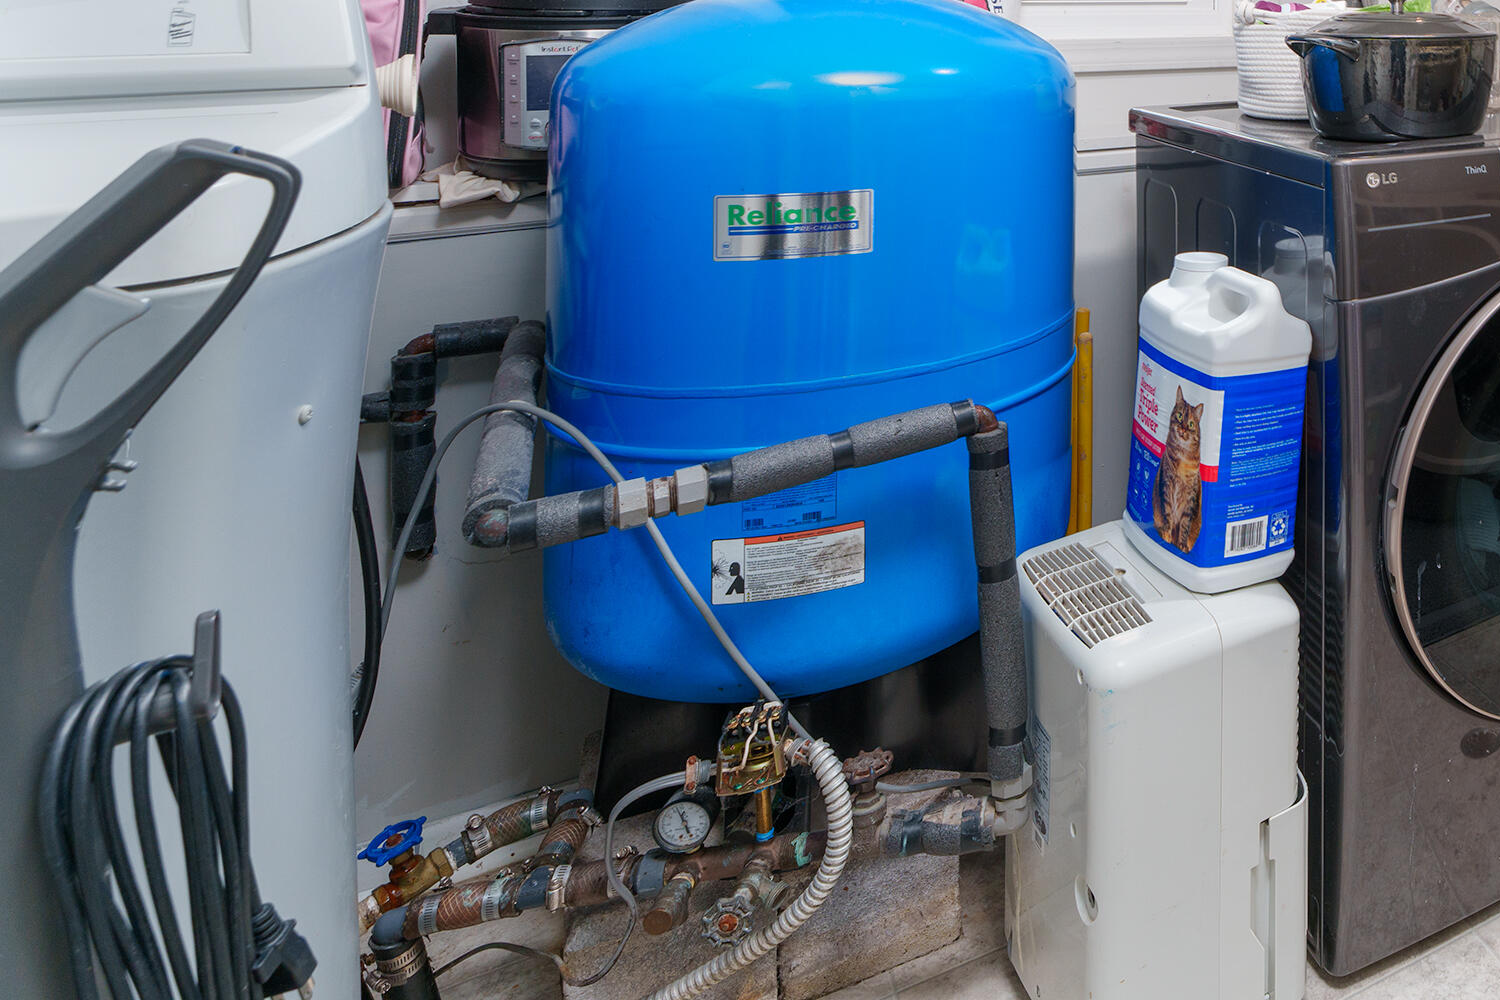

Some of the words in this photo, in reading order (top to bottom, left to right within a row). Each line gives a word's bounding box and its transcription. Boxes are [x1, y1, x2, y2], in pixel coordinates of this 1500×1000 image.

[1464, 164, 1488, 175] ThinQ
[728, 201, 857, 226] Reliance
[1139, 387, 1158, 416] Triple
[1137, 404, 1158, 434] Power
